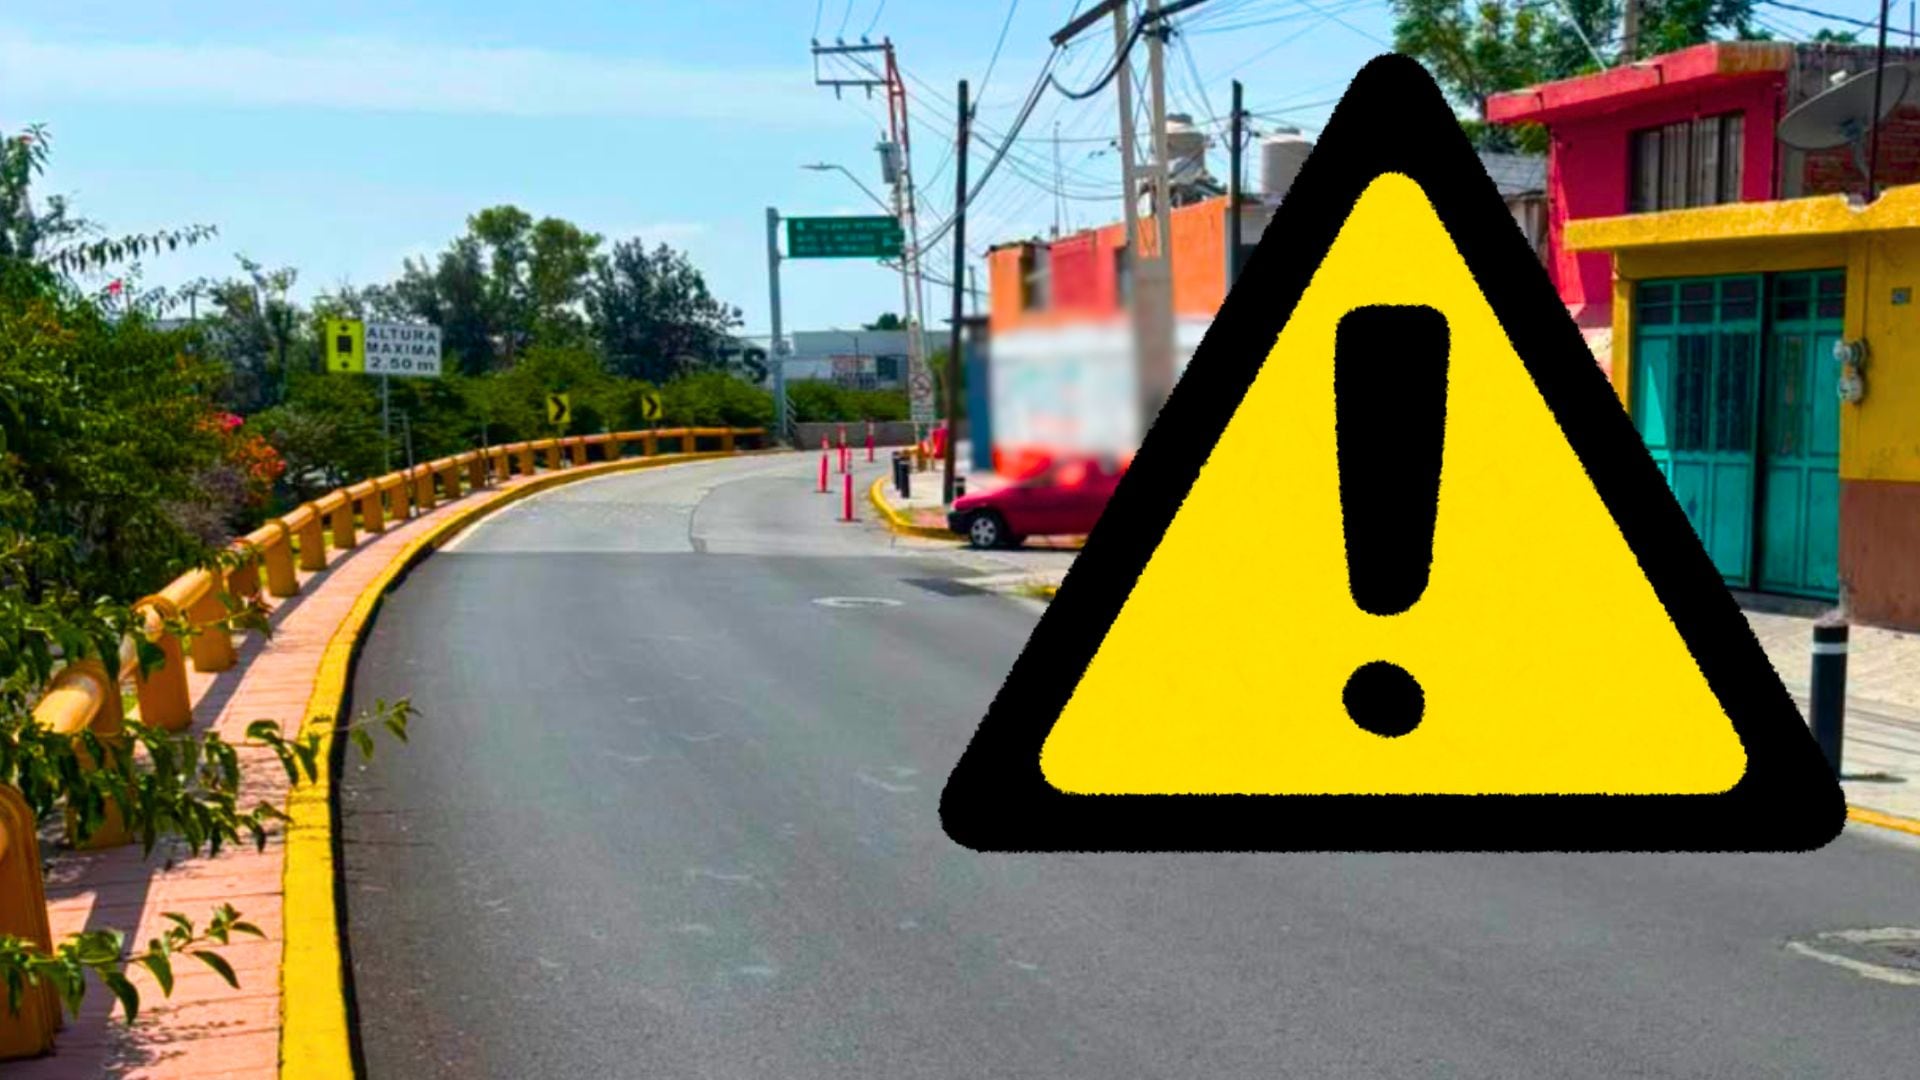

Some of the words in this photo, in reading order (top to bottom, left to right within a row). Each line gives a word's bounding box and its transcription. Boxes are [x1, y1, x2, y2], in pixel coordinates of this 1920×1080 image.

[367, 327, 437, 342] ALTURA
[366, 341, 437, 357] MAXIMA
[370, 356, 413, 370] 2.50
[417, 361, 435, 371] m
